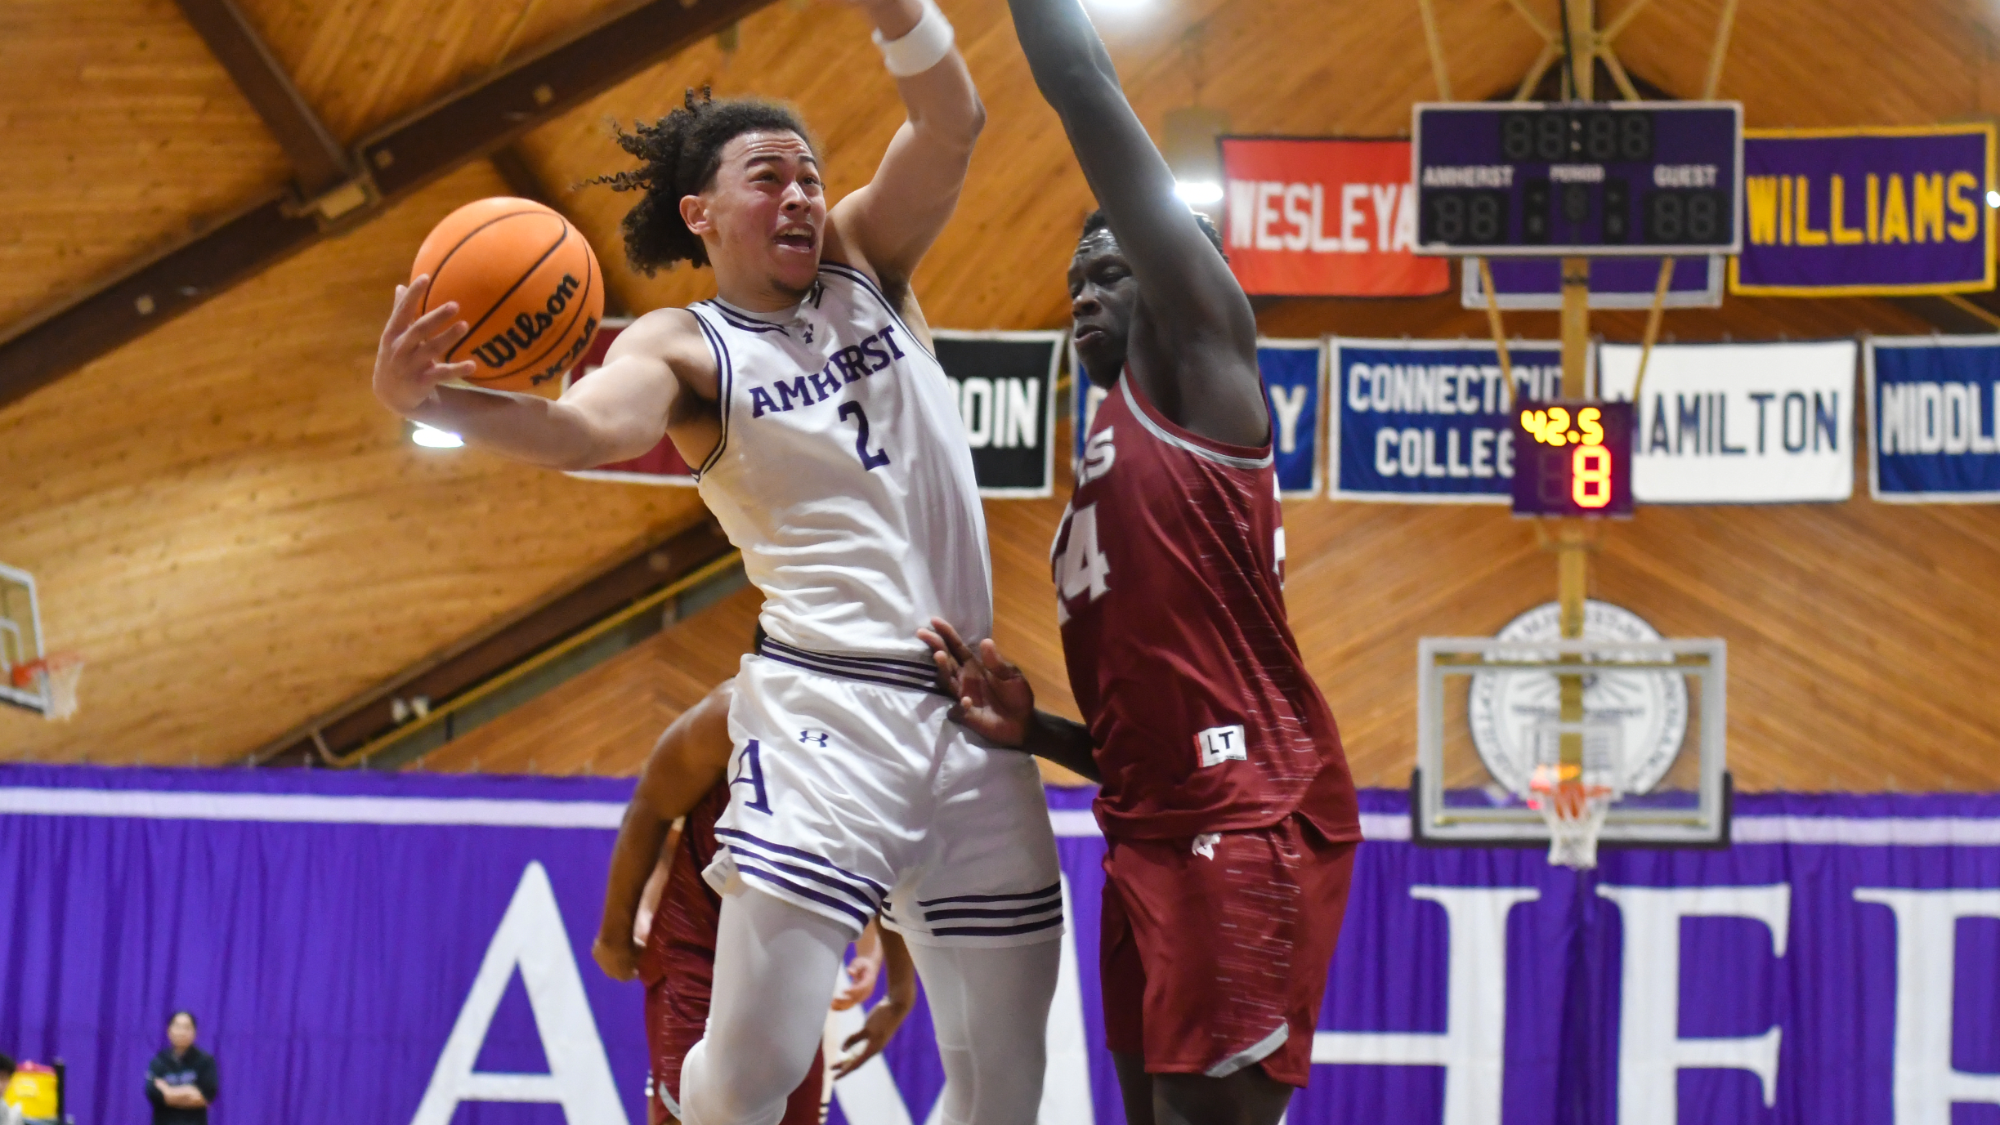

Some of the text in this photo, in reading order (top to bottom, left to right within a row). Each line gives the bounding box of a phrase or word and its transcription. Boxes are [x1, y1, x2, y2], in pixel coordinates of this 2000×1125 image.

[1423, 165, 1514, 187] AMHERST
[1654, 163, 1717, 187] GUEST
[1747, 172, 1979, 246] WILLIAMS
[470, 272, 580, 368] Wilson
[1348, 362, 1563, 416] CONNECTICU
[837, 400, 890, 471] 2
[1520, 406, 1604, 447] 42.5
[1632, 388, 1839, 456] AMILTON
[1571, 444, 1612, 508] 8
[1207, 730, 1234, 755] LT
[729, 739, 773, 816] A
